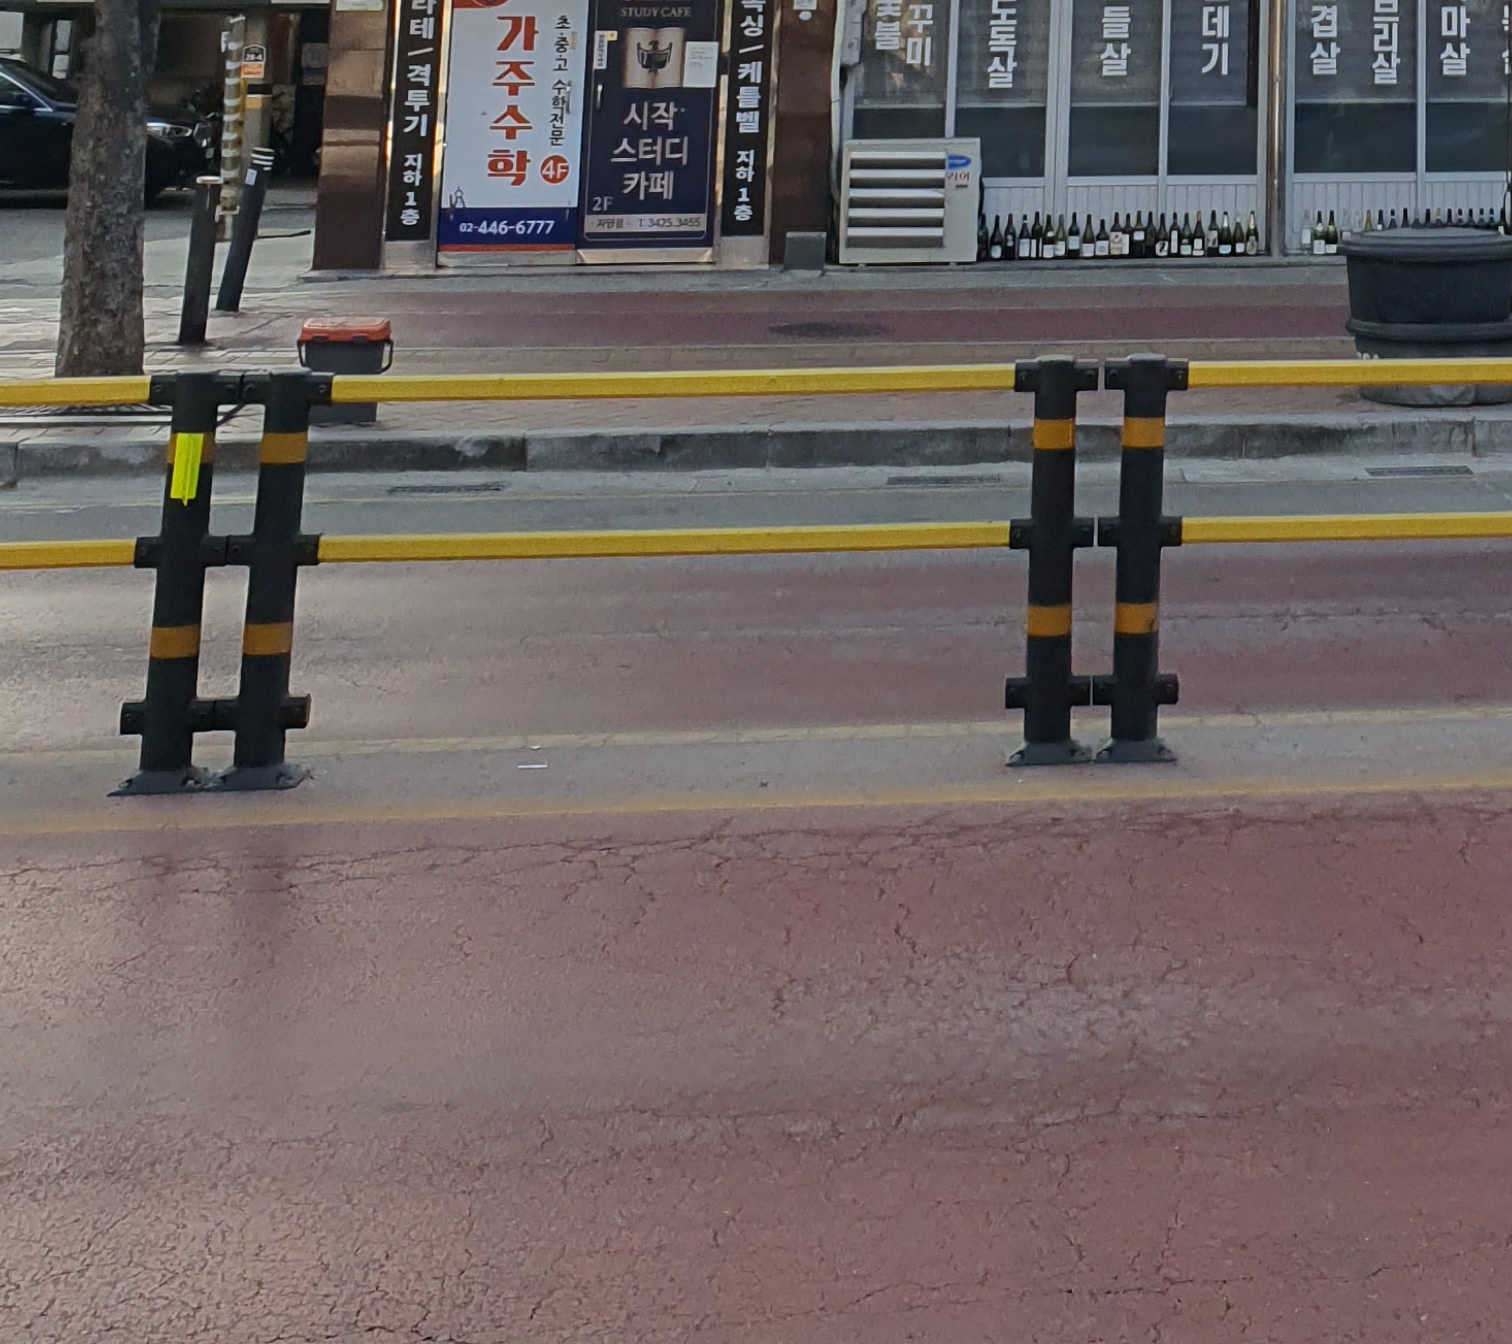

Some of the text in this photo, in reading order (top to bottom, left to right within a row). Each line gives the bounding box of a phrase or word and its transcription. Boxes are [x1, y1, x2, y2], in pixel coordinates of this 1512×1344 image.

[660, 6, 692, 18] CAFE
[486, 15, 540, 187] 가주수학
[549, 78, 567, 147] 수학전문
[623, 101, 678, 131] 시작
[610, 136, 688, 166] 스터디
[541, 159, 570, 180] 4F
[622, 171, 674, 200] 카페
[592, 196, 613, 211] 2F
[458, 219, 556, 235] 02-446-6777
